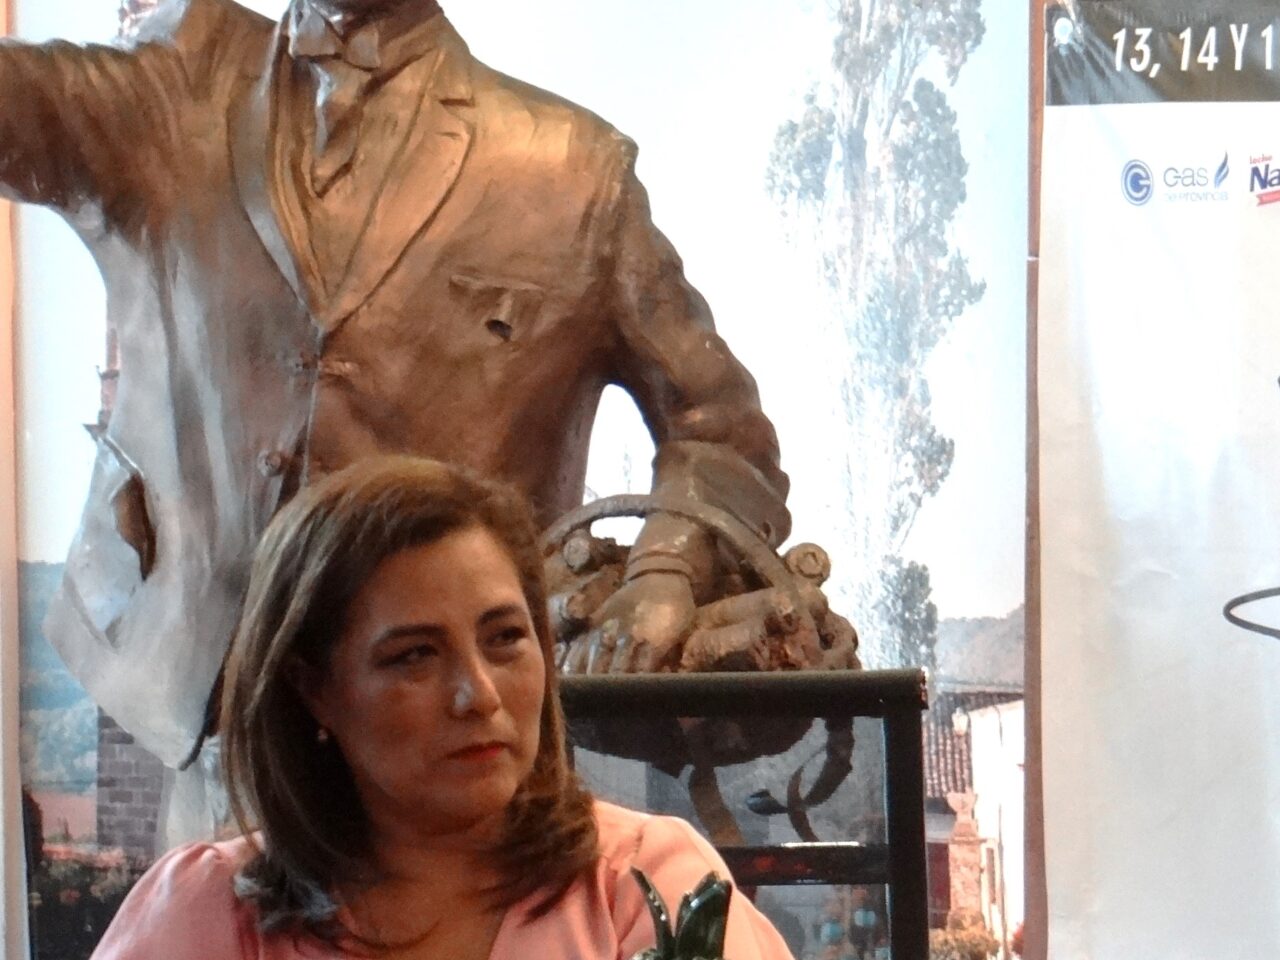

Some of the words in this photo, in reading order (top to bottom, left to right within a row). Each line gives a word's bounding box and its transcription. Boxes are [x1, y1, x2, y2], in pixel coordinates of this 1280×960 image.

[1112, 27, 1161, 78] 13,
[1178, 25, 1219, 72] 14
[1229, 23, 1249, 71] Y
